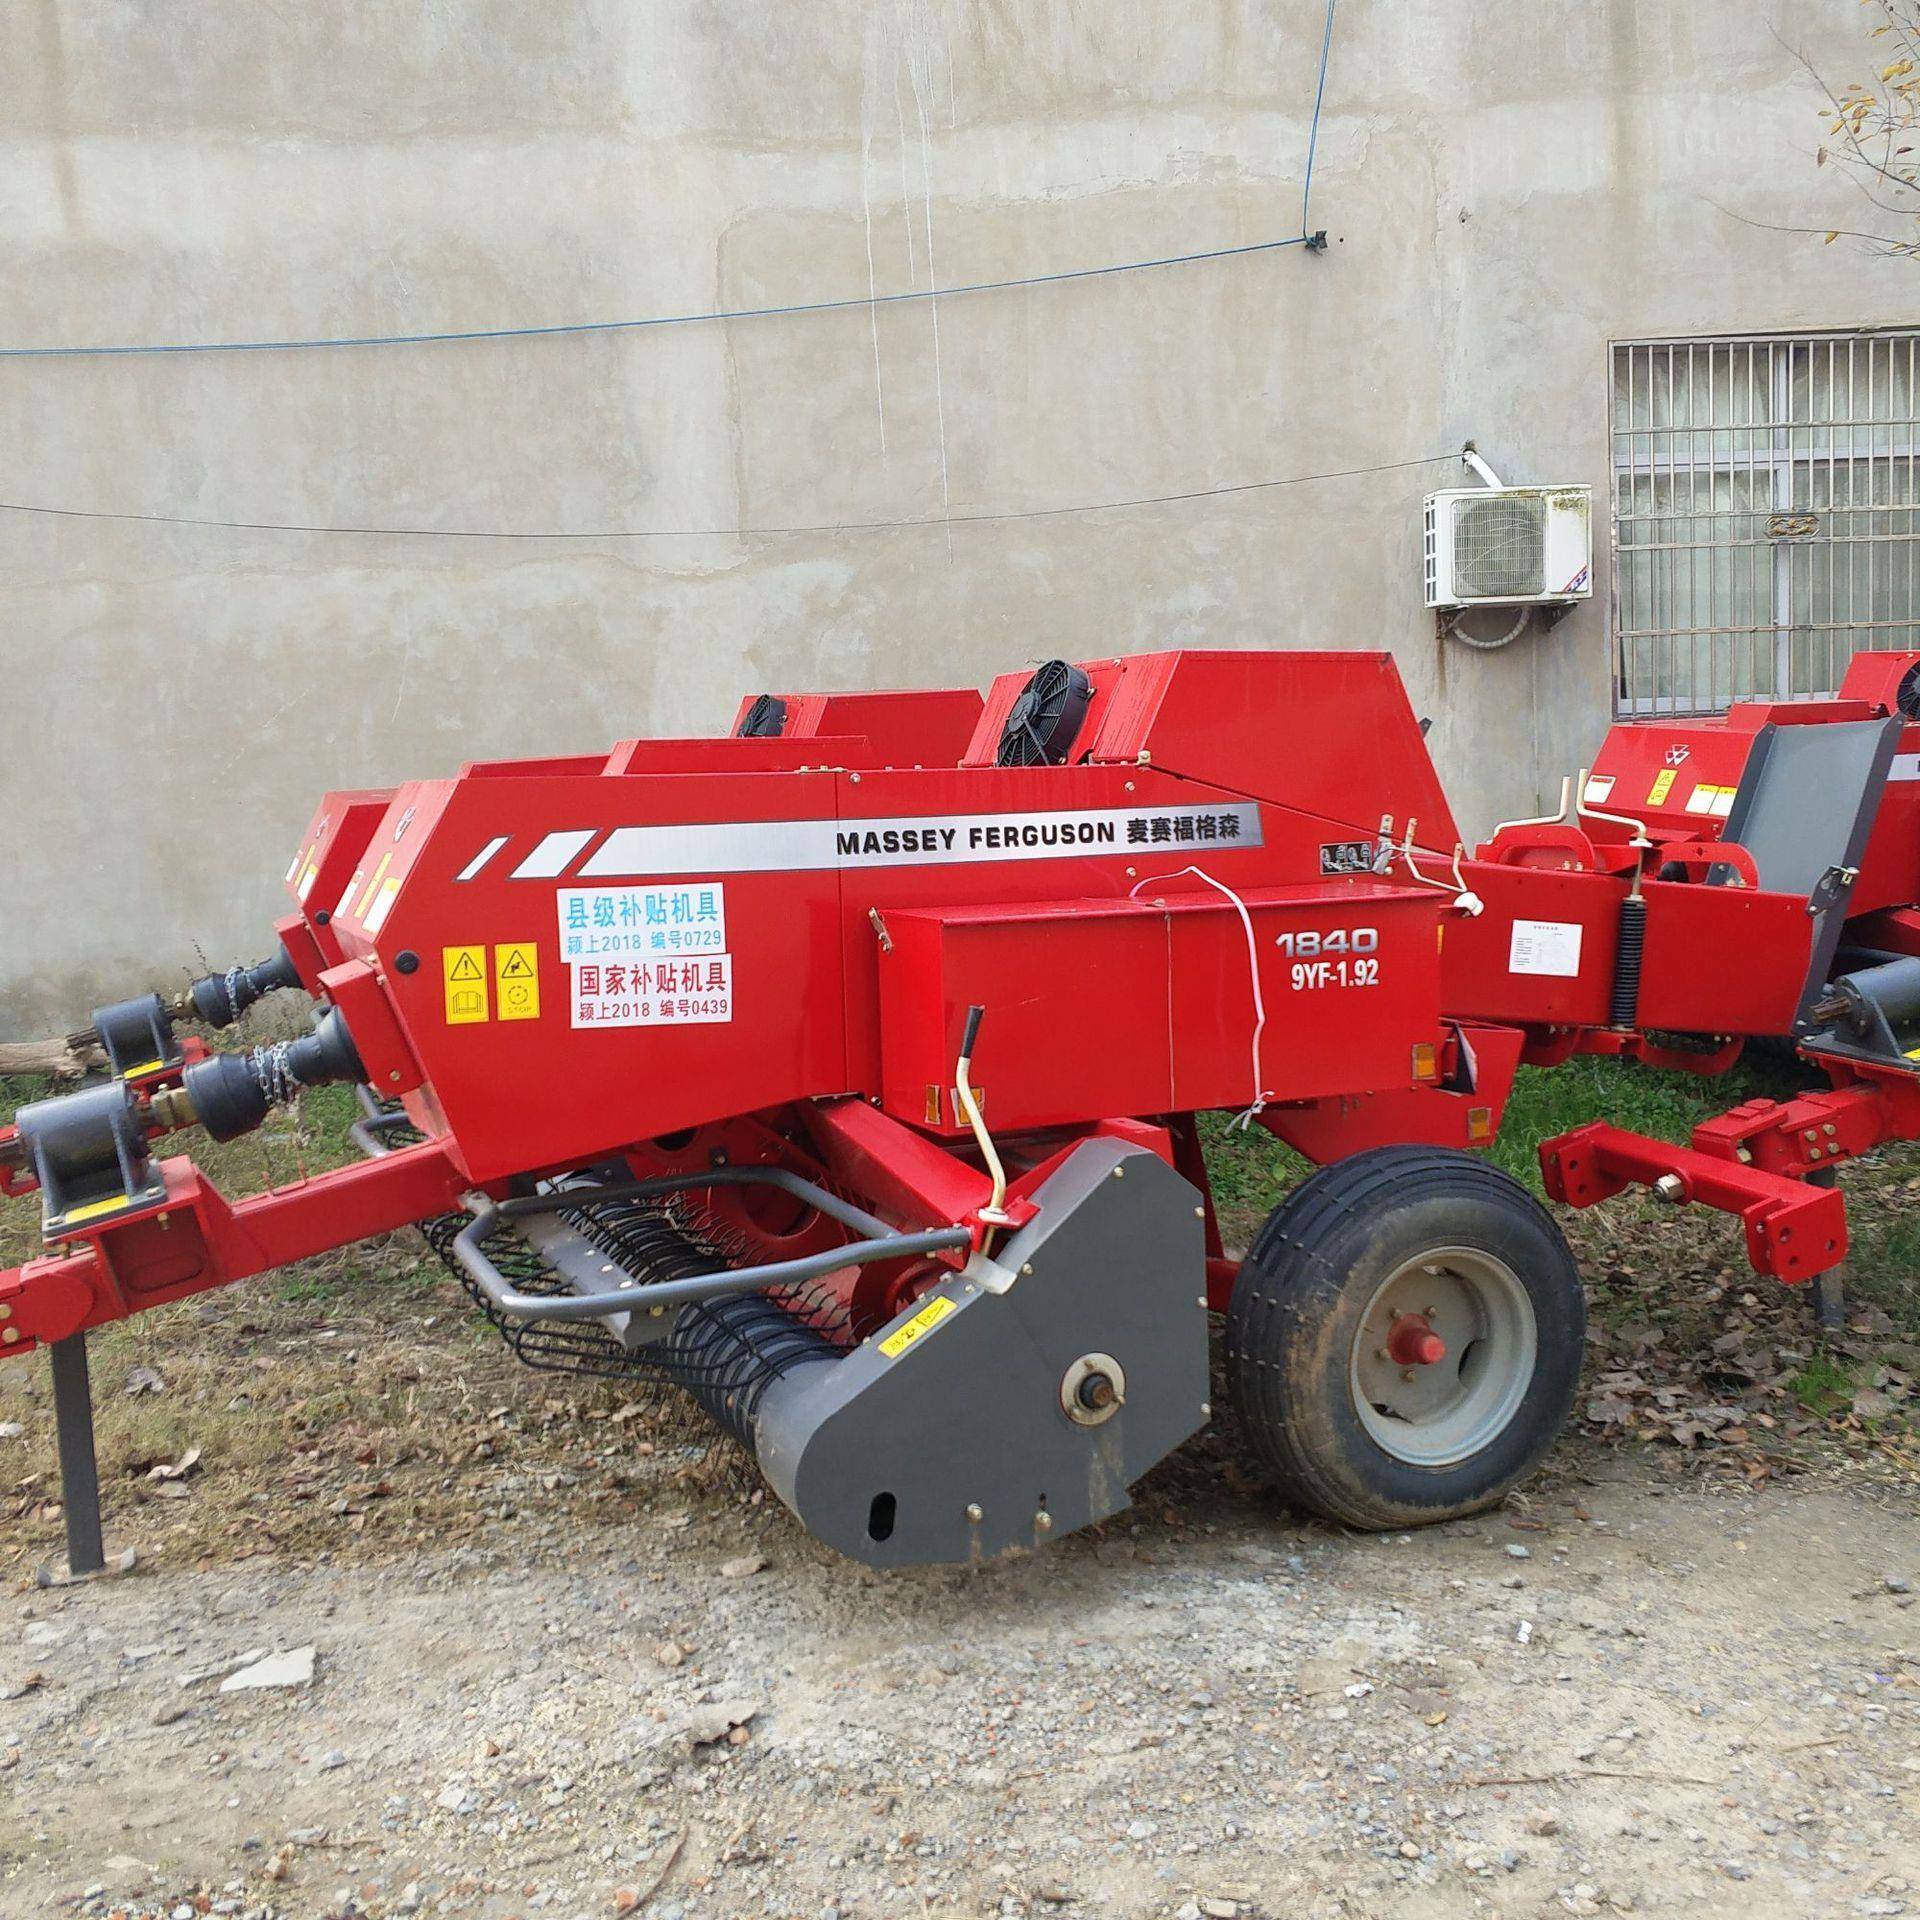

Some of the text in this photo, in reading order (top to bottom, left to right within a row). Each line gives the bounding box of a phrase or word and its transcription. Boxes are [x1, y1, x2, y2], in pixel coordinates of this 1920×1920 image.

[837, 813, 1240, 855] MASSEY FERGUSON 麦赛福格森
[567, 891, 718, 929] 县级补贴机具
[650, 930, 721, 953] 编号0729
[1275, 927, 1378, 958] 1840
[579, 963, 726, 996] 国家补贴机具
[1291, 958, 1380, 991] 9YF-1.92
[660, 999, 728, 1018] 编号0439
